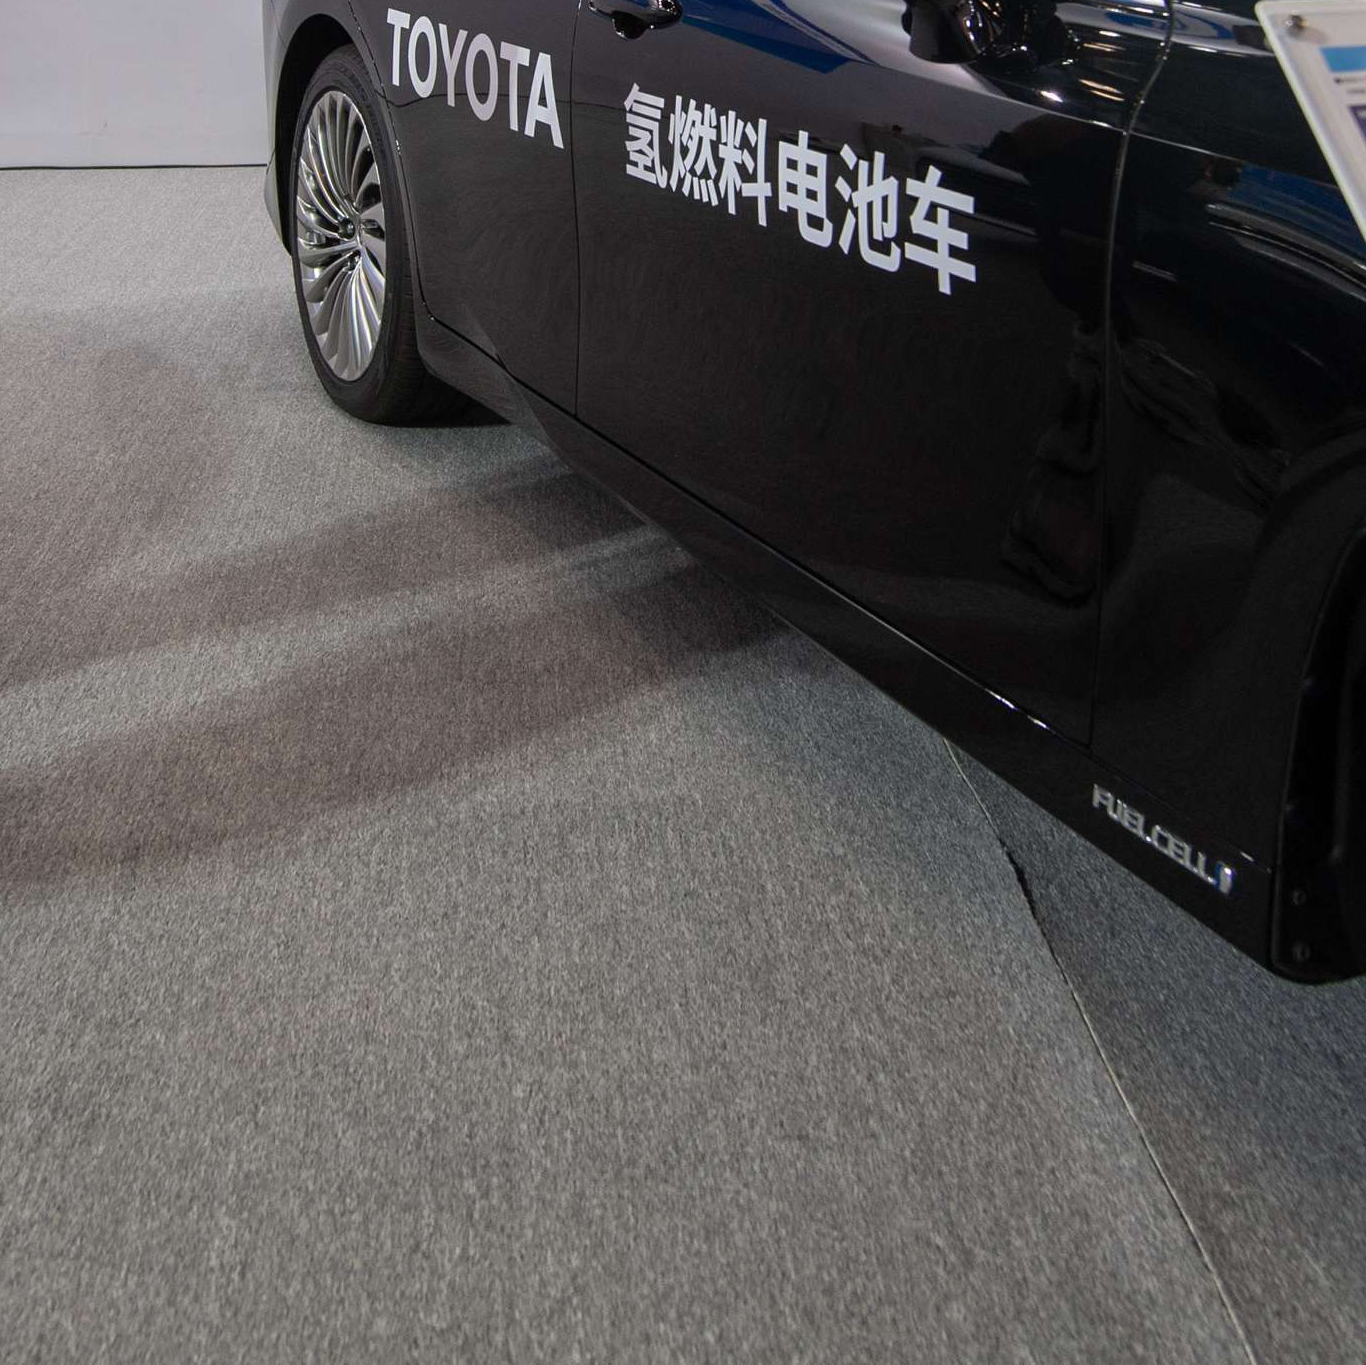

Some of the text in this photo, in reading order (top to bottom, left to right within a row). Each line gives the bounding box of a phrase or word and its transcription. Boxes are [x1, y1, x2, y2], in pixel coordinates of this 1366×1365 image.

[387, 8, 564, 149] TOYOTA
[623, 82, 977, 296] 氢燃料电池车
